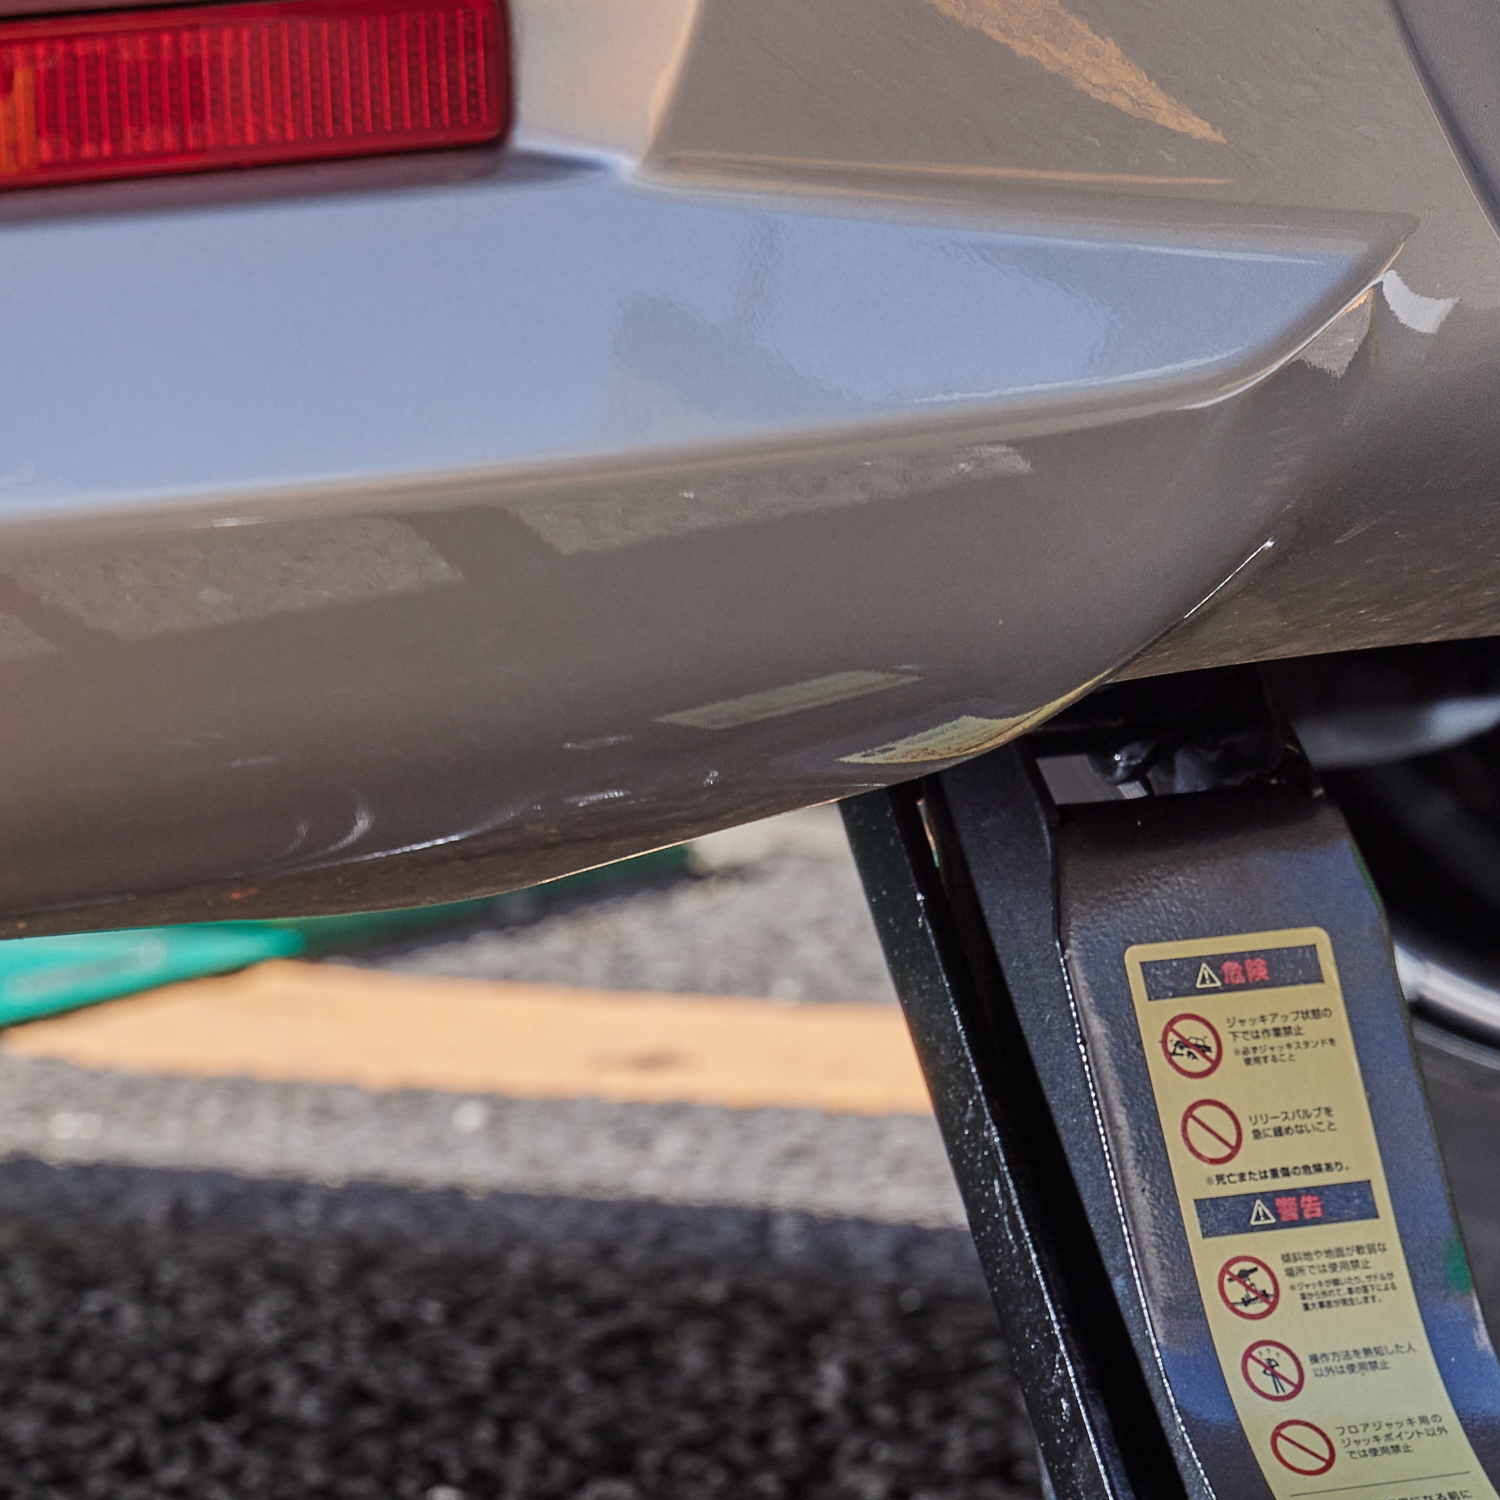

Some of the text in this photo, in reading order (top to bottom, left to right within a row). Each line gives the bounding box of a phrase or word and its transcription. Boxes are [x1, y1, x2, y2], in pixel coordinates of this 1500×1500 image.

[1221, 957, 1270, 985] 危険
[1226, 1007, 1332, 1028] ジャッキアップ状態の
[1228, 1024, 1305, 1042] 下では作業禁止
[1243, 1053, 1296, 1067] 使用すること
[1248, 1106, 1333, 1126] リリースバルブを
[1251, 1121, 1337, 1140] 急に緩めないこと
[1274, 1193, 1323, 1222] 警告
[1284, 1258, 1372, 1278] 場所では使用禁止
[1308, 1342, 1416, 1365] 操作方法を熟知した人
[1312, 1360, 1391, 1378] 以外は使用禁止
[1335, 1414, 1442, 1436] フロアジャッキ用の
[1341, 1426, 1448, 1448] ジャッキポイント以外
[1346, 1443, 1414, 1460] では使用禁止
